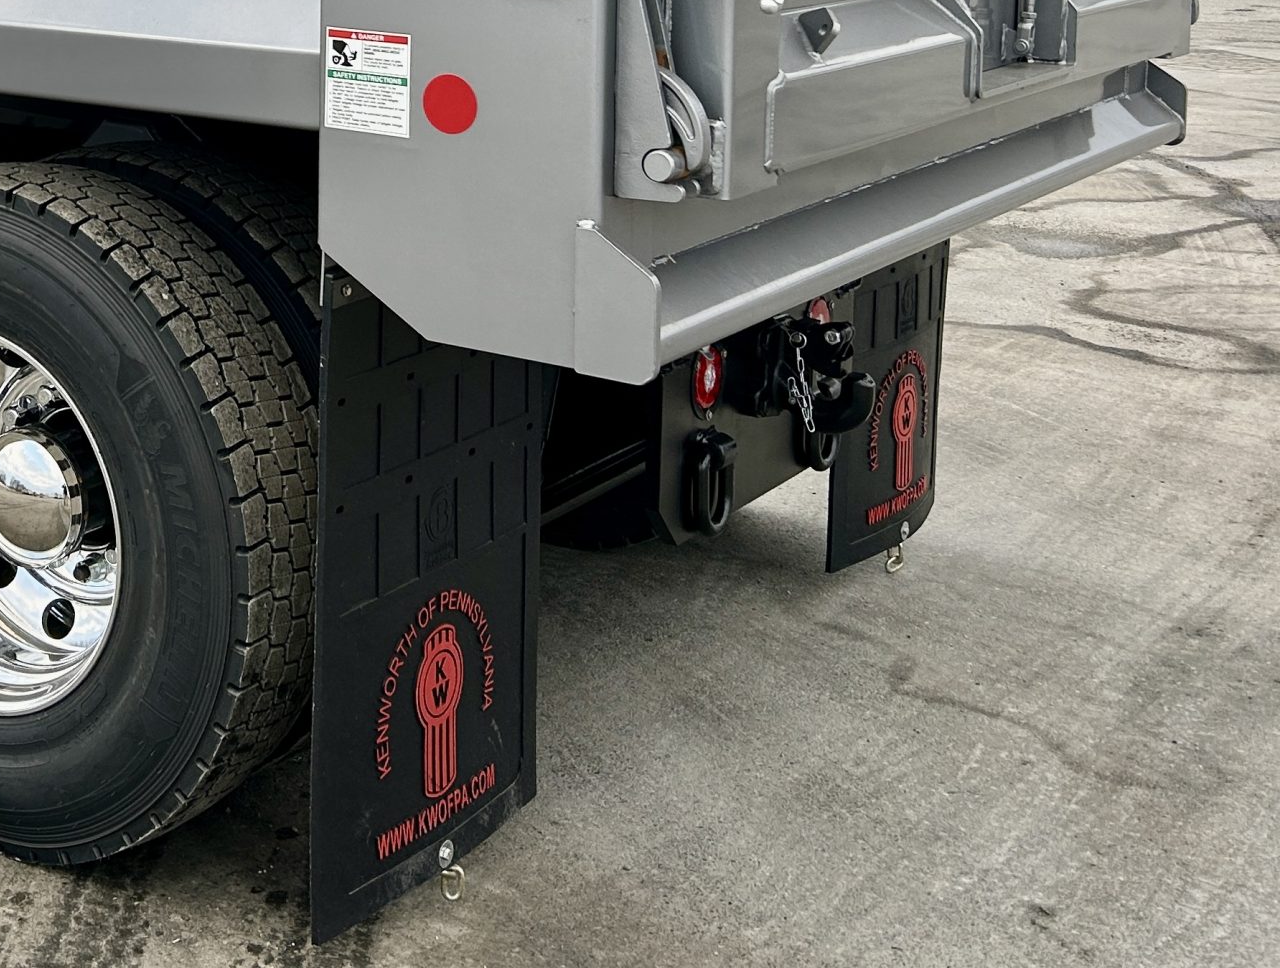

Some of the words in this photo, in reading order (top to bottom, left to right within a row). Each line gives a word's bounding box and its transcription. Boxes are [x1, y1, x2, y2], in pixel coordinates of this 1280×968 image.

[332, 71, 356, 80] SAFETY
[356, 73, 402, 85] INSTRUCTIONS
[358, 33, 385, 42] DANGER
[869, 368, 897, 472] KENWORTH
[376, 623, 418, 780] KENWORTH
[418, 596, 437, 629] OF
[440, 589, 495, 712] PENNSYLVANIA
[376, 763, 496, 861] WWW.KWOFPA.COM
